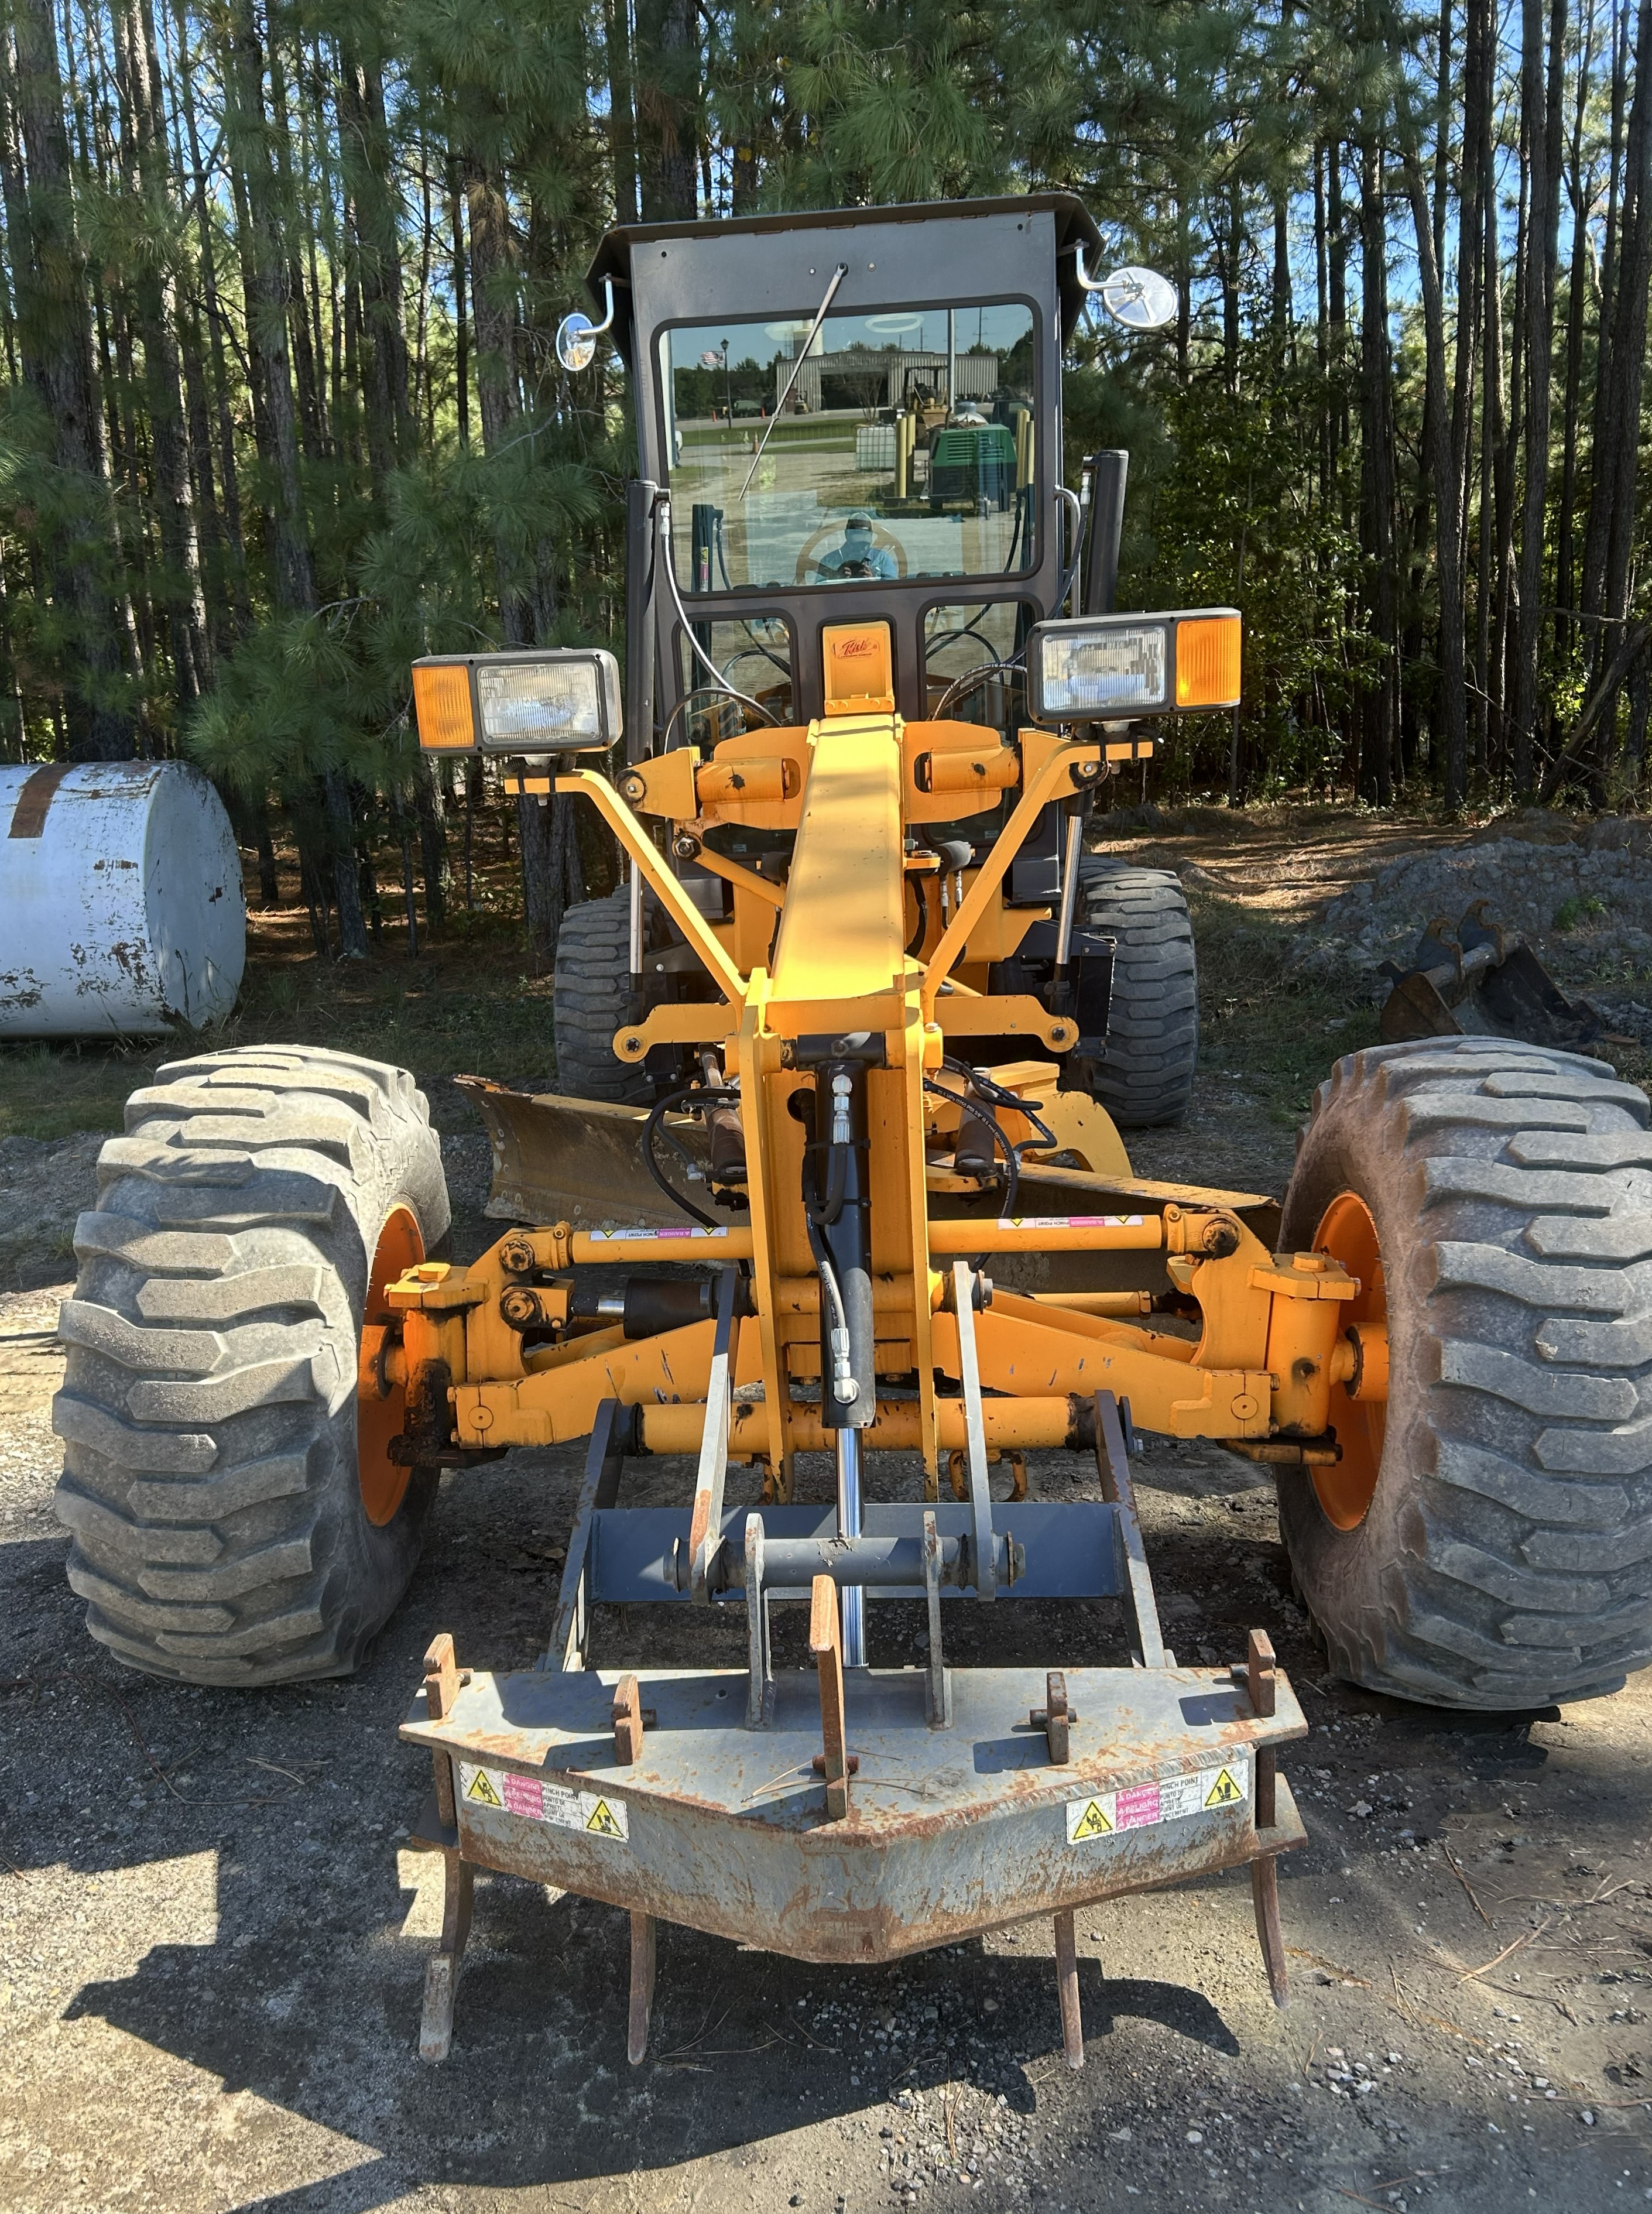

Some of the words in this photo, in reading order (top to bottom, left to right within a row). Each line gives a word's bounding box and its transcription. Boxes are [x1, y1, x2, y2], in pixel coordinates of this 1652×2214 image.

[511, 1778, 540, 1791] DANGER
[1160, 1781, 1178, 1791] PINCH
[1180, 1777, 1198, 1787] POINT
[542, 1786, 560, 1797] PINCH
[1125, 1799, 1159, 1814] PELIGRO
